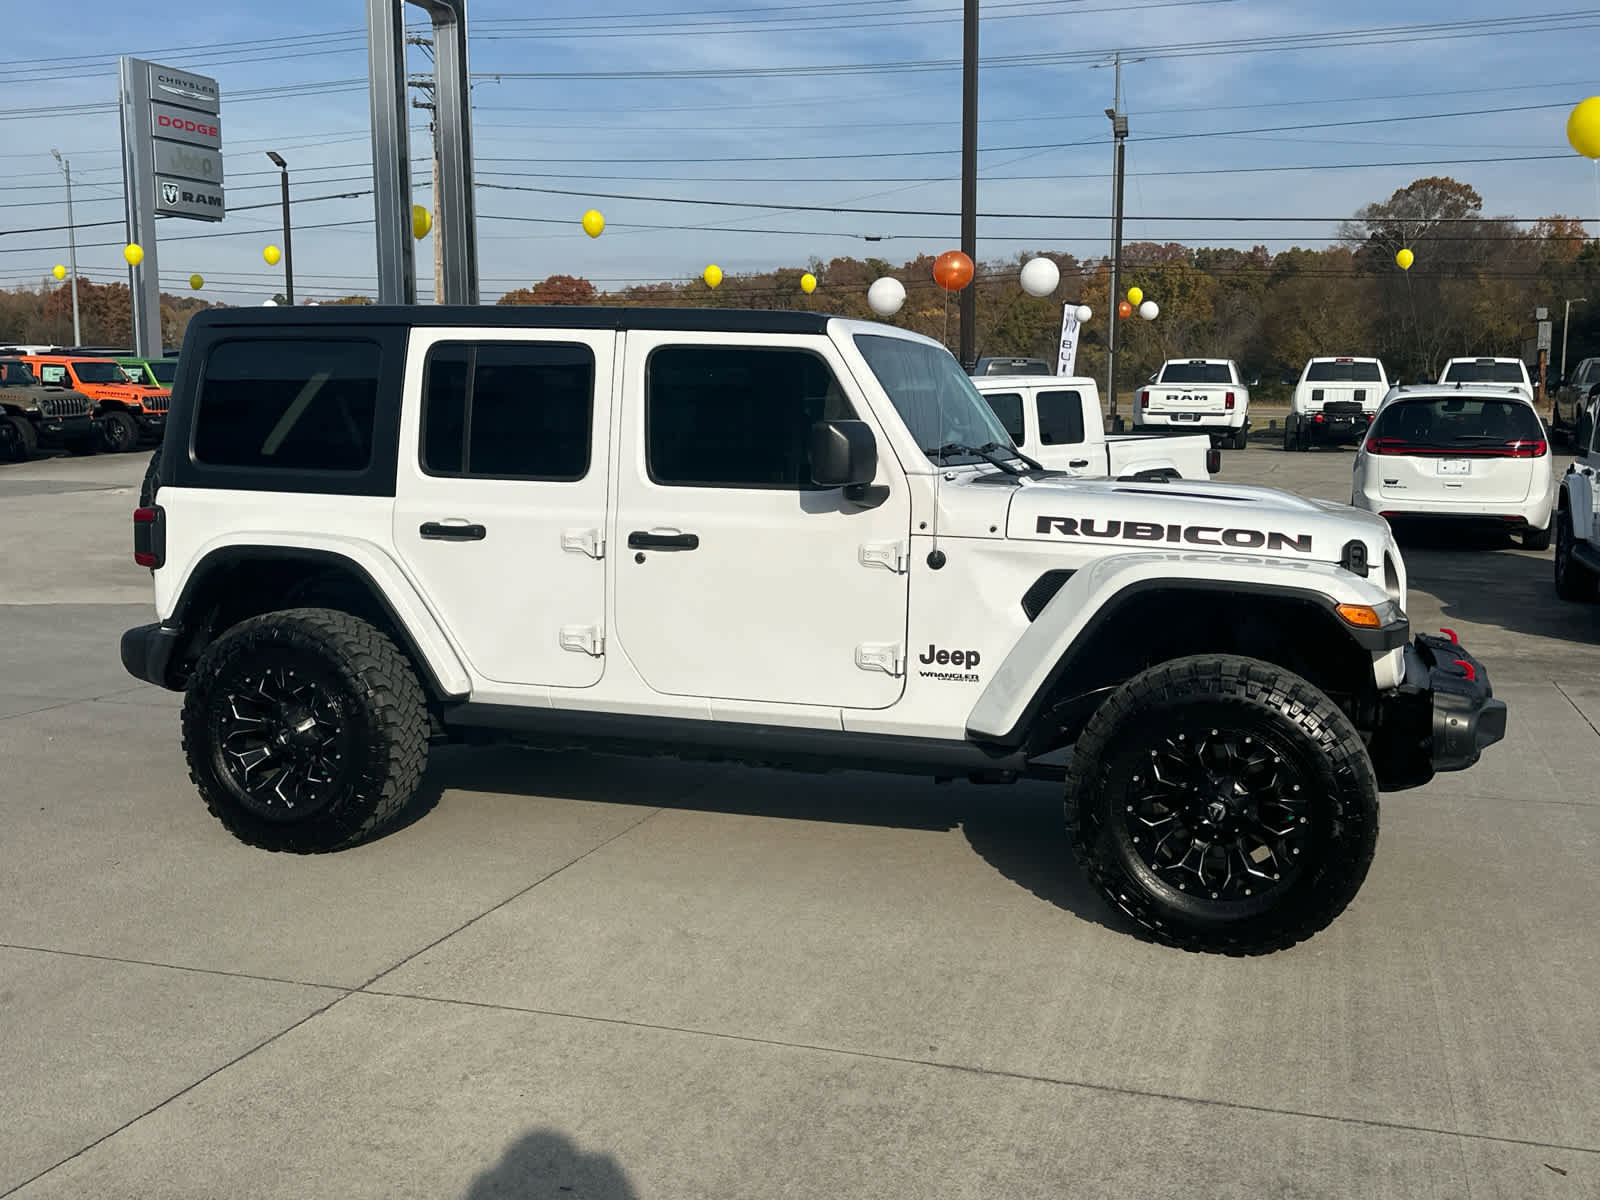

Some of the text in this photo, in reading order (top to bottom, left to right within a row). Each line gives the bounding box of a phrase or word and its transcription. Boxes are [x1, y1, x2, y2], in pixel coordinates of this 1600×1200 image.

[158, 75, 215, 93] CHRYSLER
[158, 115, 217, 136] DODGE
[182, 191, 222, 207] RAM
[1036, 515, 1313, 553] RUBICON
[919, 644, 981, 670] Jeep
[919, 671, 979, 680] WRANGLER
